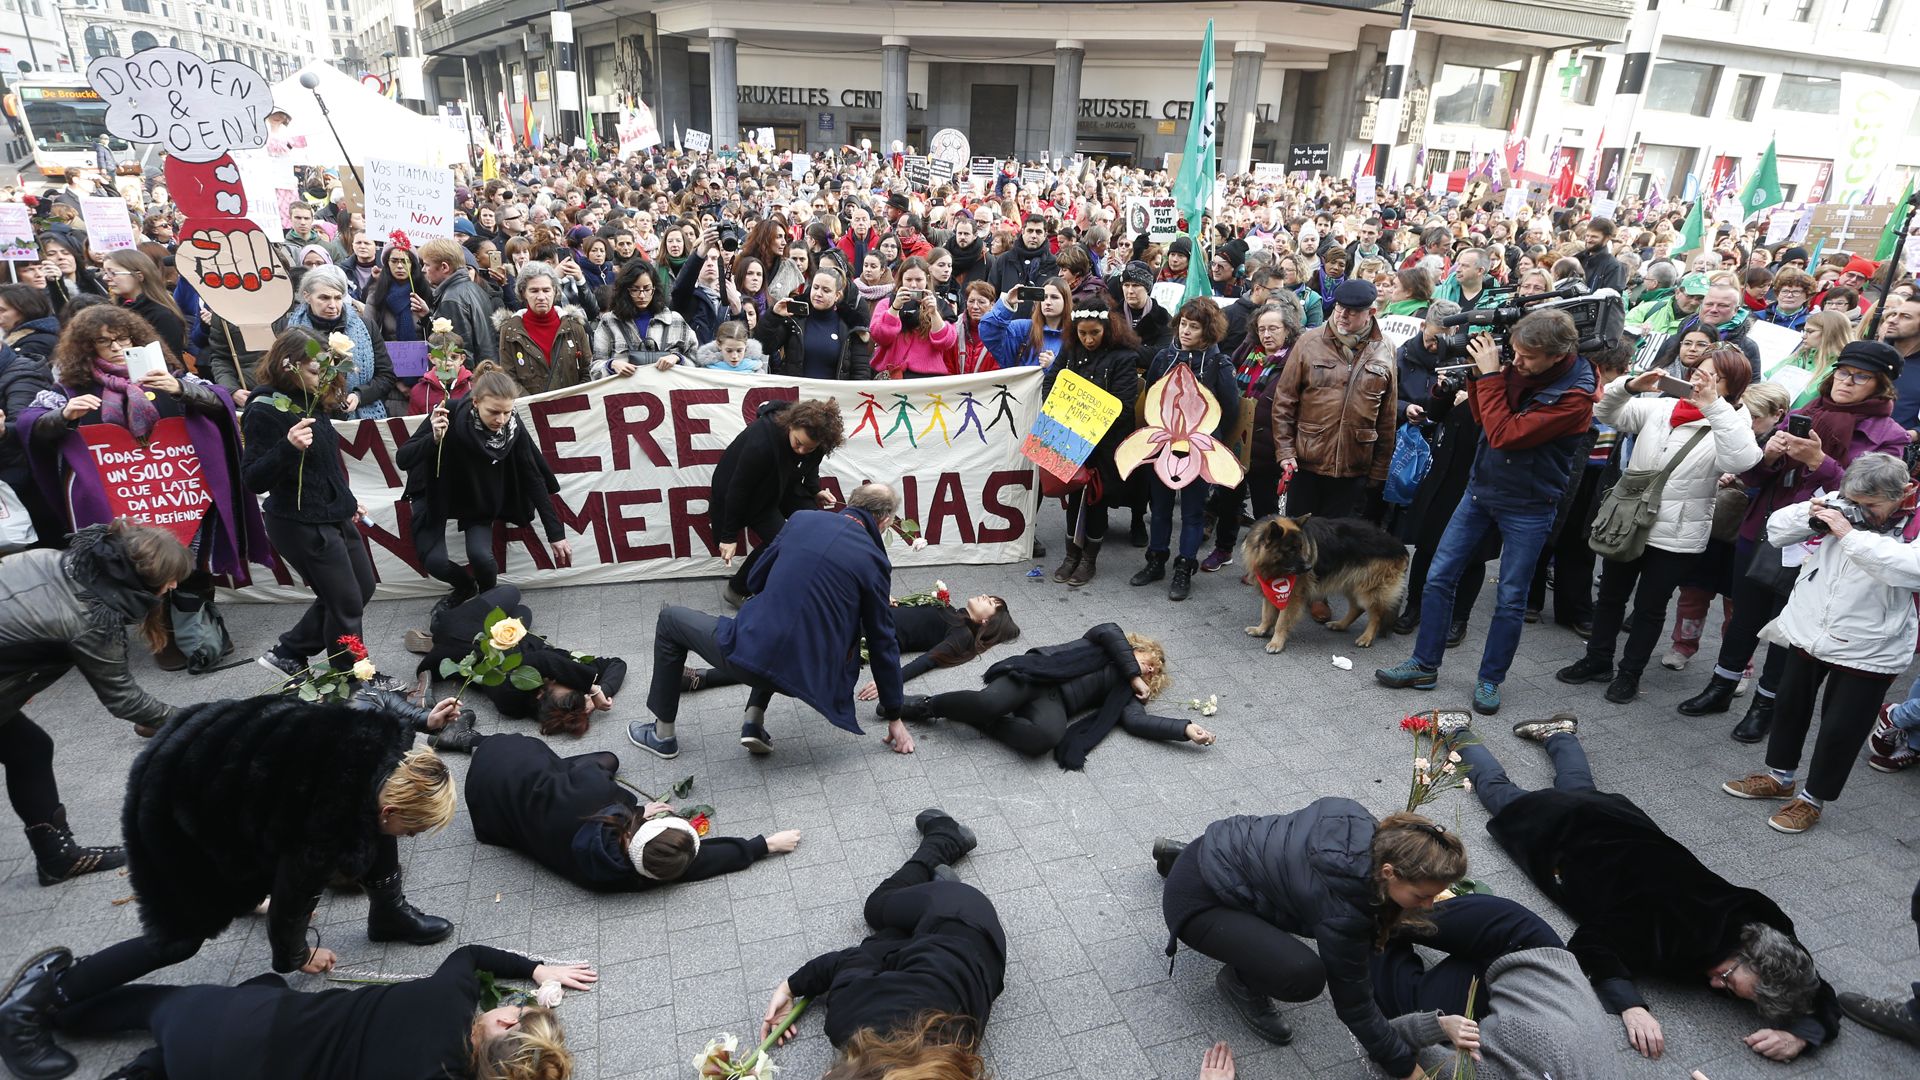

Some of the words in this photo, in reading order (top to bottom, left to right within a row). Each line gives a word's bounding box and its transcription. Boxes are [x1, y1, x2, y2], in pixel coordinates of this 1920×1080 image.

[96, 60, 252, 100] DROMEN
[168, 90, 192, 119] &
[841, 89, 924, 111] CENTL
[1078, 98, 1152, 119] RUSSEL
[131, 105, 264, 151] DOEN!
[1105, 121, 1136, 129] INGANG
[398, 184, 441, 199] SOEURS
[410, 212, 443, 226] NON
[1153, 208, 1171, 216] PEUT
[1063, 378, 1076, 392] TO
[1077, 388, 1102, 408] DEFEND
[337, 387, 800, 489] MERE
[88, 443, 146, 466] TODAS
[149, 441, 196, 460] SOMO
[106, 468, 128, 483] UN
[129, 462, 174, 482] SOLO
[117, 484, 152, 498] QUE
[161, 478, 201, 493] LATE
[127, 498, 149, 511] DA
[151, 496, 169, 508] LA
[166, 490, 213, 507] VIDA
[155, 509, 204, 525] DEFIENDE
